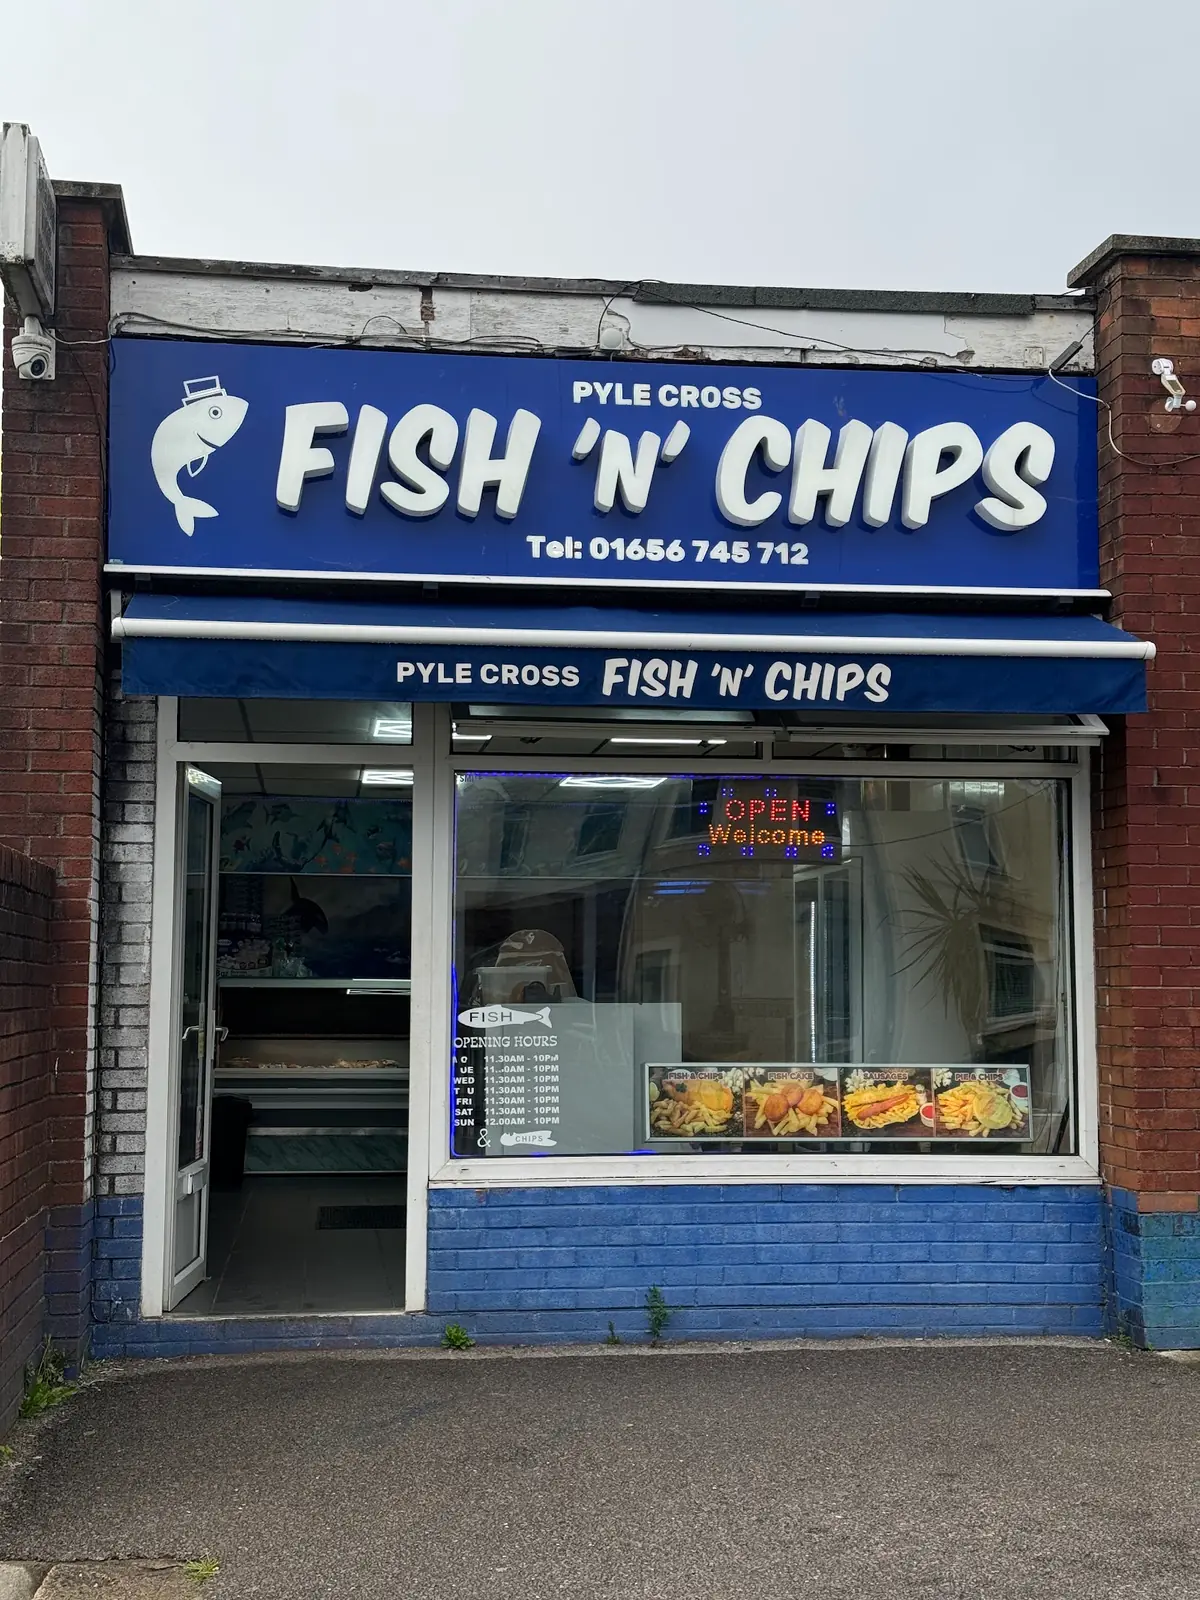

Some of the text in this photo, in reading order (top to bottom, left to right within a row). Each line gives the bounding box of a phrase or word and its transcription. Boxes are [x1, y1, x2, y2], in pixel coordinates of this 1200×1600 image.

[573, 381, 762, 410] PYLE CROSS
[276, 401, 1056, 531] FISH 'N' CHIPS
[526, 535, 809, 565] Tel: 01656 745 712
[396, 658, 892, 703] PYLE CROSS FISH 'N' CHIPS
[725, 799, 811, 821] OPEN
[708, 823, 826, 846] Welcome
[469, 1011, 513, 1022] FISH
[453, 1035, 558, 1048] OPENING HOURS
[484, 1055, 525, 1063] 11.30AM
[460, 1066, 474, 1074] UE
[533, 1065, 559, 1073] 10PM
[484, 1076, 525, 1084] 11.30AM
[534, 1075, 560, 1083] 10PM
[668, 1072, 723, 1081] FISH & CHIPS
[768, 1072, 814, 1081] FISH CAKE
[863, 1072, 908, 1081] SAUSAGES
[955, 1073, 1003, 1082] PIE & CHIPS
[454, 1087, 475, 1095] TU
[484, 1086, 525, 1094] 11.30AM
[534, 1085, 560, 1094] 10PM
[484, 1097, 525, 1105] 11.30AM
[534, 1096, 560, 1104] 10PM
[455, 1108, 474, 1116] SAT
[484, 1107, 525, 1115] 11.30AM
[534, 1106, 560, 1114] 10PM
[454, 1119, 475, 1127] SUN
[484, 1118, 525, 1126] 12.00AM
[534, 1117, 560, 1125] 10PM
[477, 1128, 543, 1148] & CHIPS
